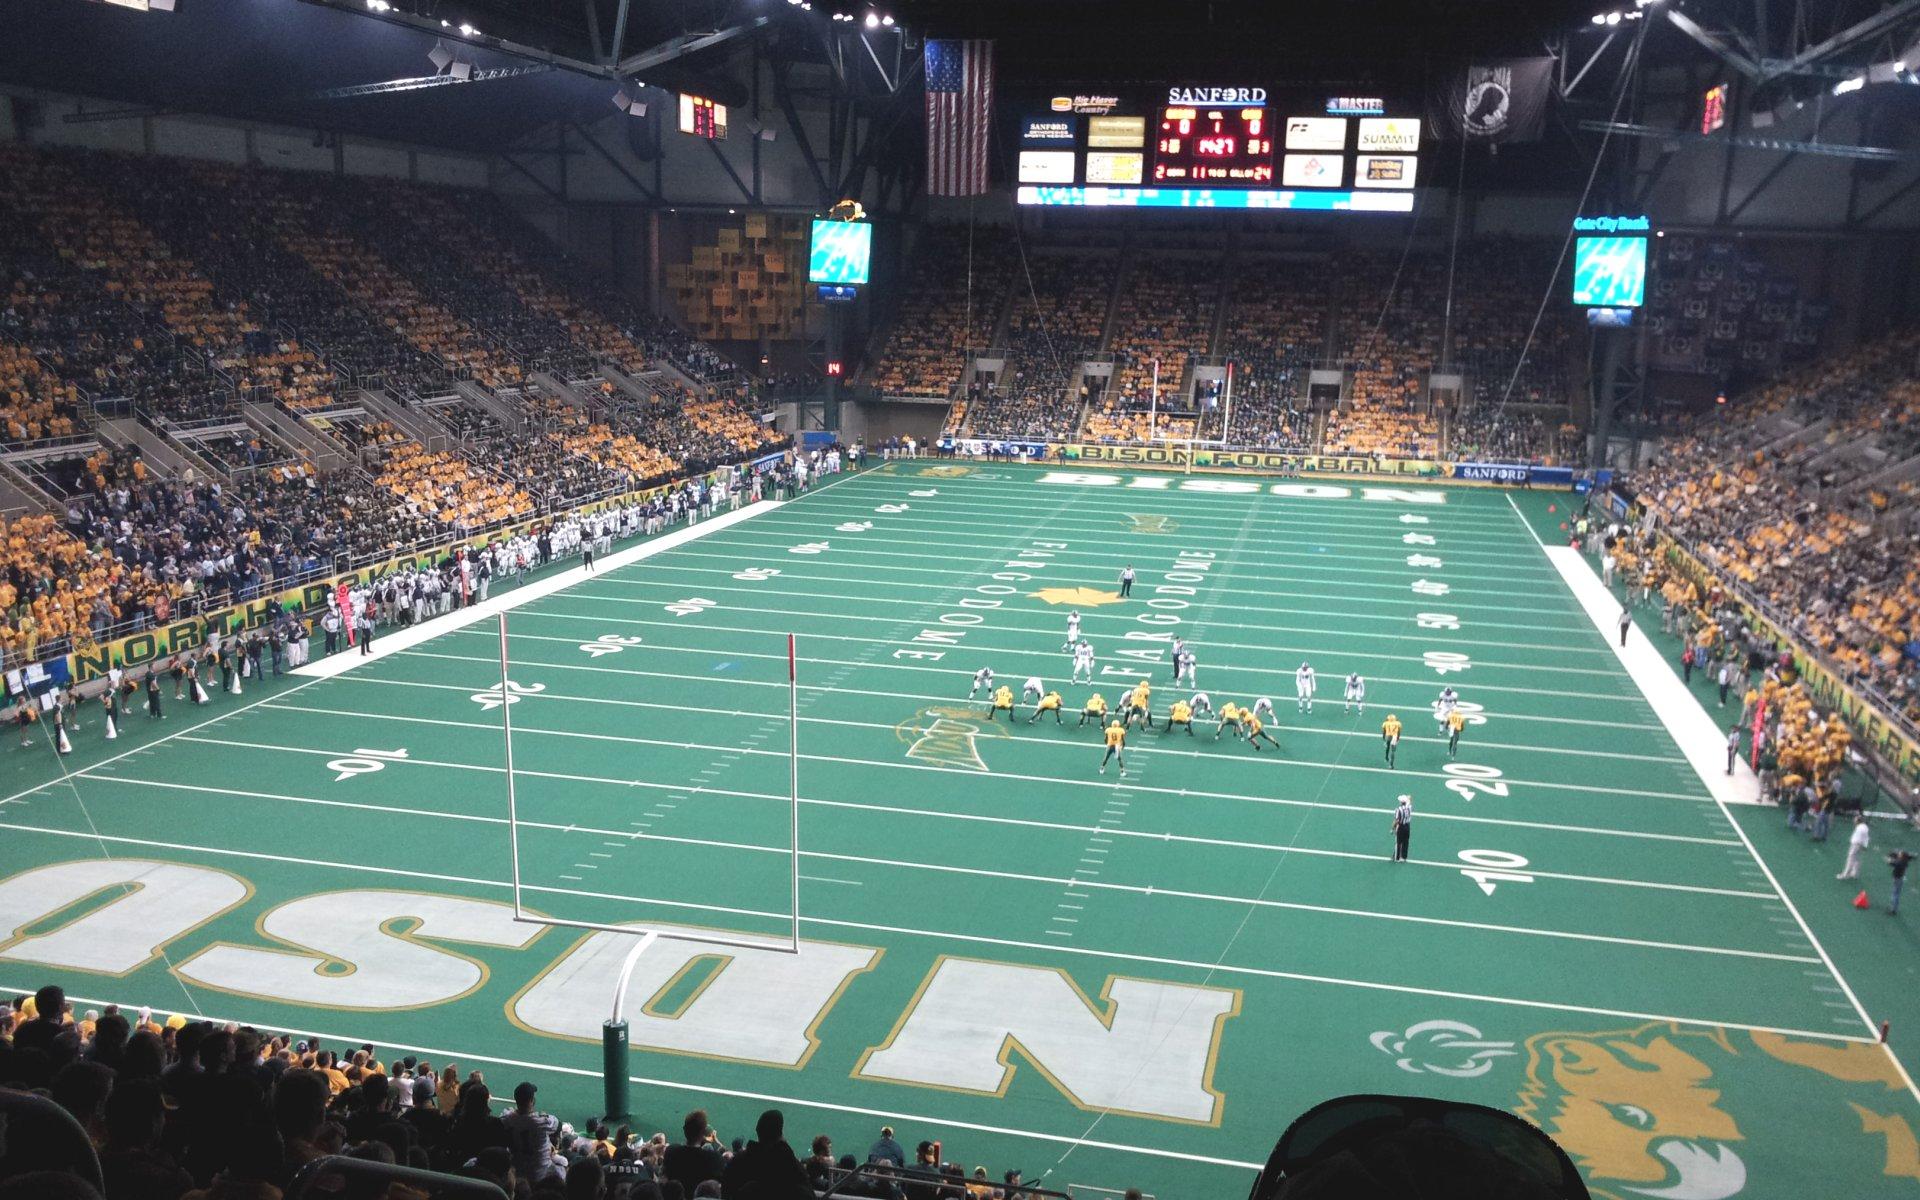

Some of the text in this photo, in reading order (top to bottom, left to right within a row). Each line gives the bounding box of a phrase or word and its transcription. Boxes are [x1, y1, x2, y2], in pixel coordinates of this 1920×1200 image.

[1168, 87, 1267, 102] SANFORD
[1338, 97, 1383, 111] MASTER
[1030, 123, 1068, 131] SANFORD
[1362, 134, 1415, 145] SUMMIT
[1156, 166, 1166, 179] 2
[1193, 166, 1206, 179] 11
[1254, 166, 1271, 180] 24
[828, 363, 840, 374] 14
[1080, 445, 1418, 476] BISON FOOTBALL
[1463, 466, 1527, 482] SANFORD
[1036, 472, 1447, 503] BISON
[732, 567, 782, 581] 50
[664, 597, 717, 613] 40
[893, 541, 1068, 662] FARGODOME
[1100, 550, 1217, 679] FARGODOME
[1416, 612, 1460, 630] 50
[74, 599, 272, 684] NORTH
[579, 634, 642, 653] 30
[470, 680, 546, 705] 20
[326, 748, 409, 774] 10
[1442, 763, 1509, 798] 20
[1458, 849, 1535, 884] 10
[0, 857, 1244, 1128] NDSU
[609, 1164, 640, 1175] NDSU
